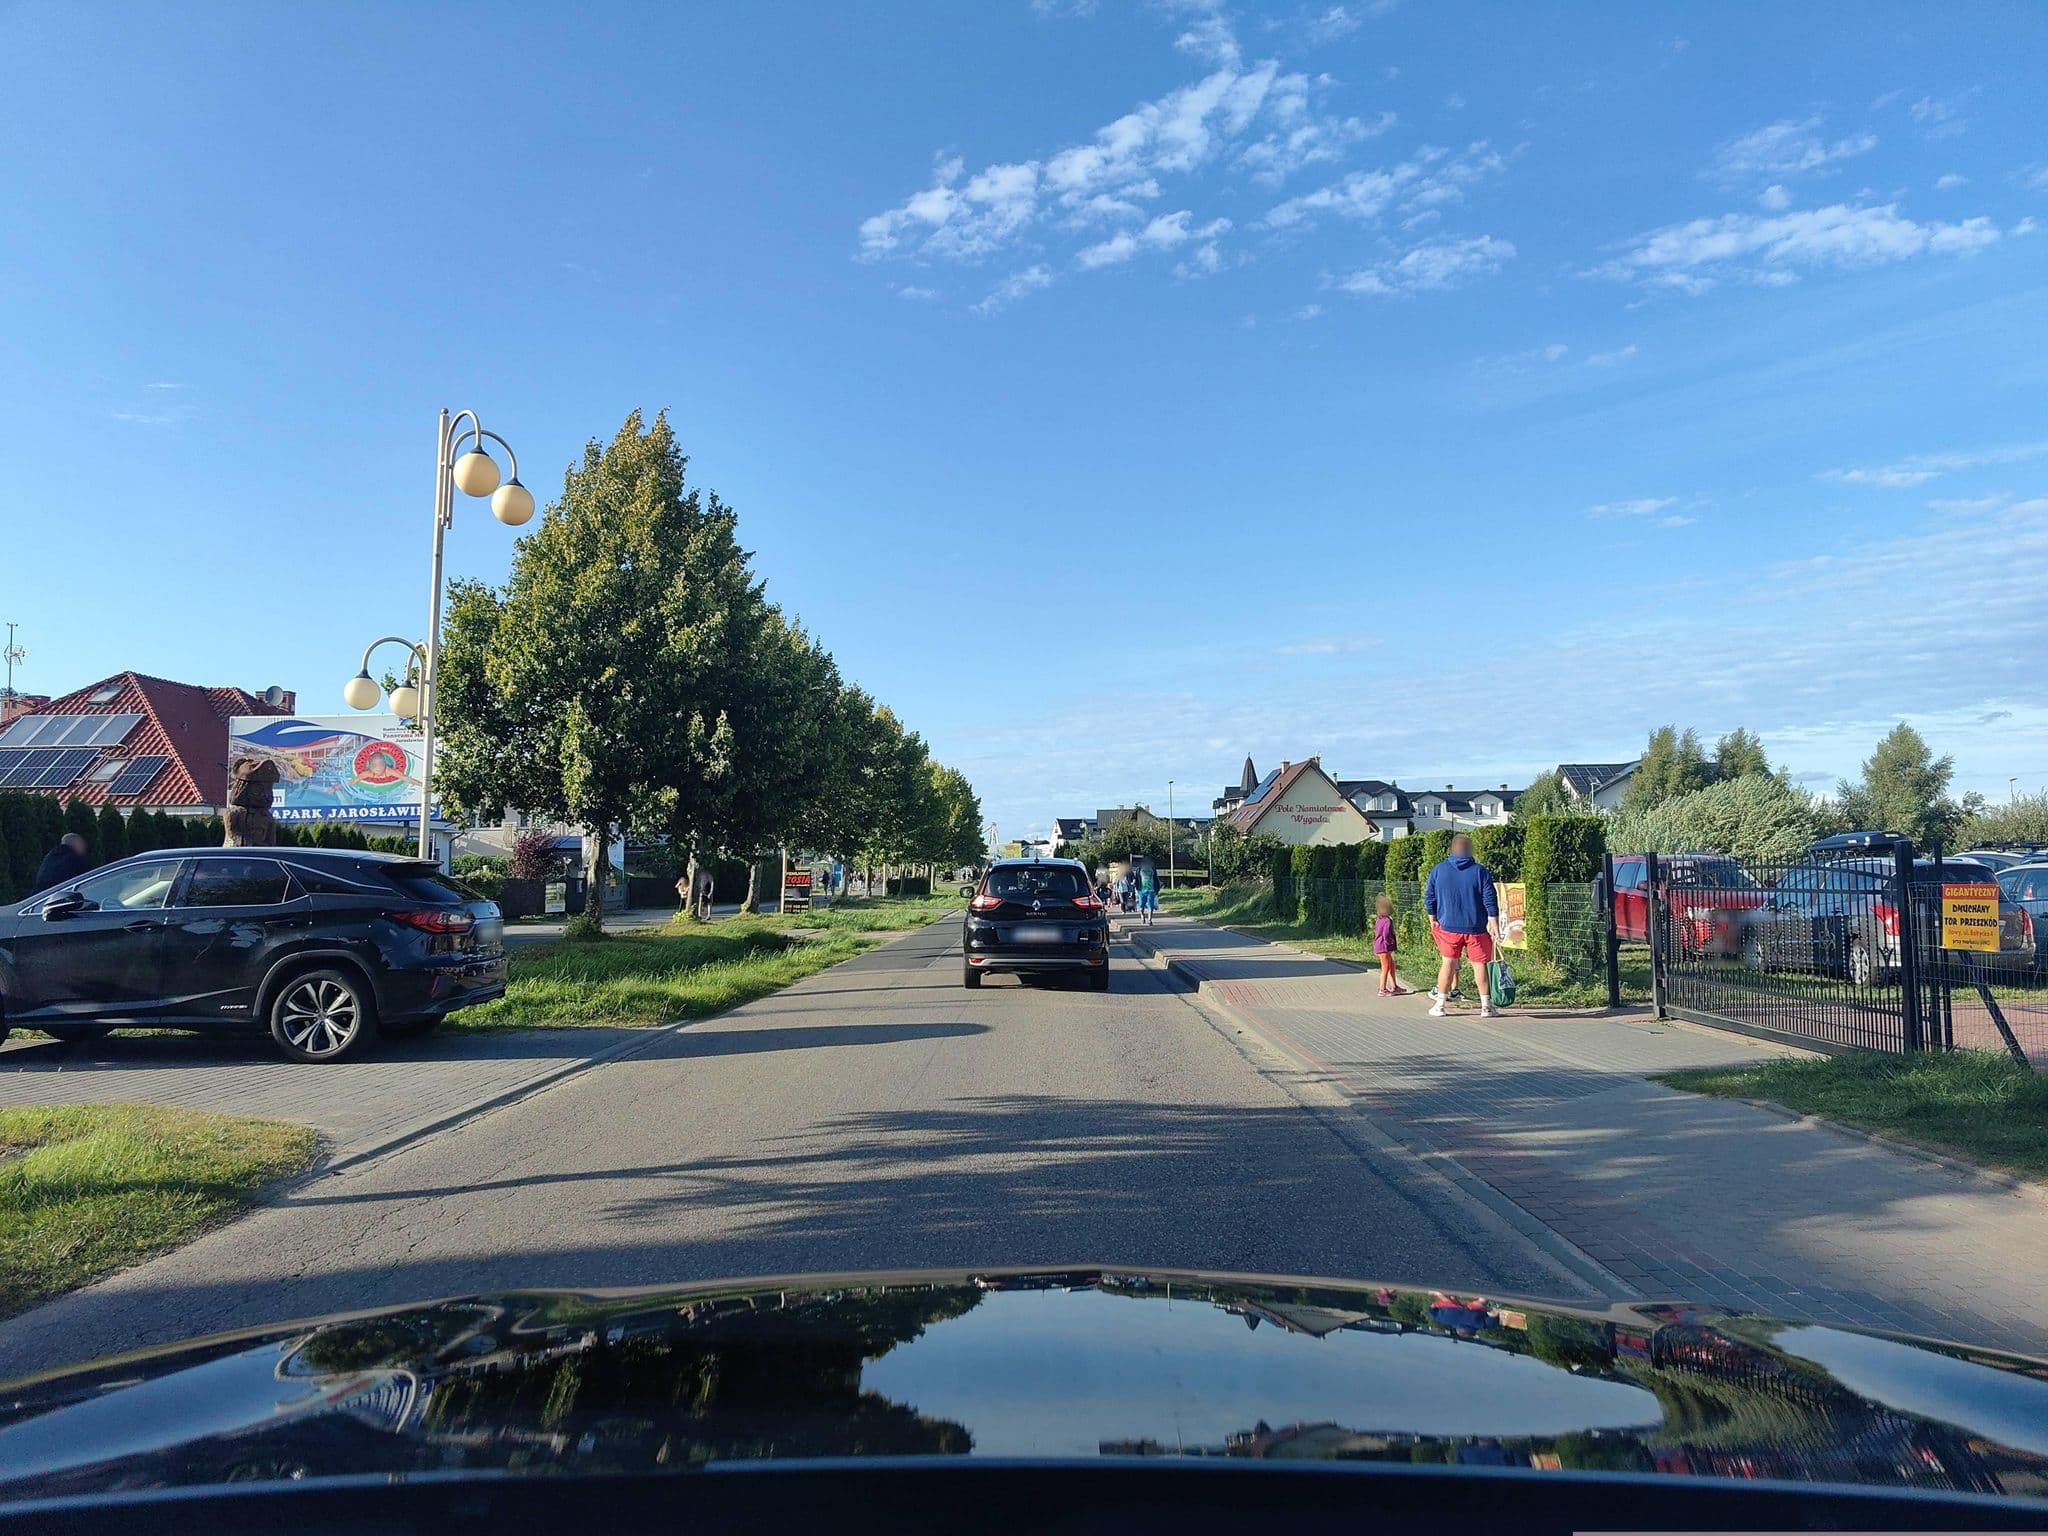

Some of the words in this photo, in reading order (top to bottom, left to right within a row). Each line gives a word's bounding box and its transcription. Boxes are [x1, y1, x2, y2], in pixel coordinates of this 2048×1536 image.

[1275, 804, 1294, 813] Pole
[272, 808, 323, 820] APARK
[1945, 887, 1997, 897] GIGANTYCZNY
[1952, 904, 1990, 913] DMUCHANY
[1944, 917, 1958, 926] TOR
[1960, 916, 1998, 928] PRZESZKÓD
